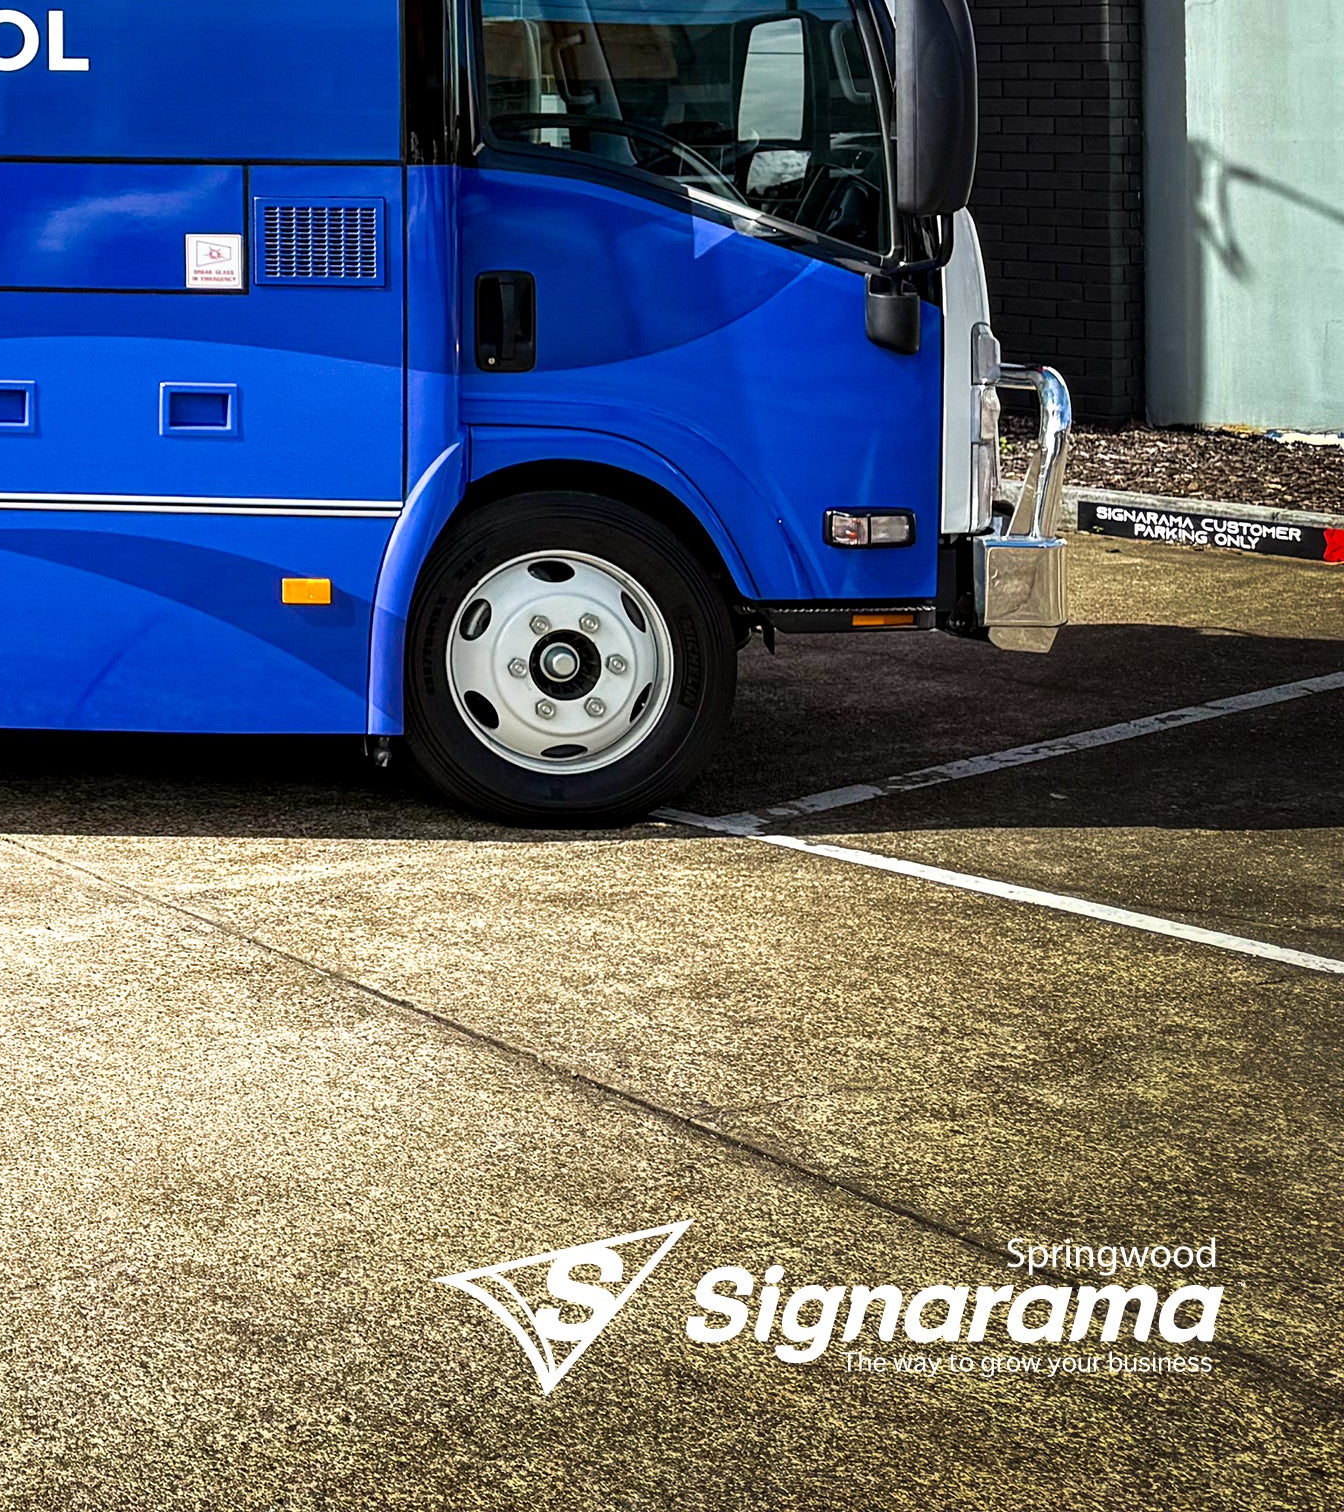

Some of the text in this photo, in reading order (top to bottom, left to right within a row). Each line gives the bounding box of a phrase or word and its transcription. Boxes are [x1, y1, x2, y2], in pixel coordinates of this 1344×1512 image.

[1096, 506, 1301, 542] SIGNARAMA CUSTOMER
[1134, 523, 1260, 550] PARKING ONLY
